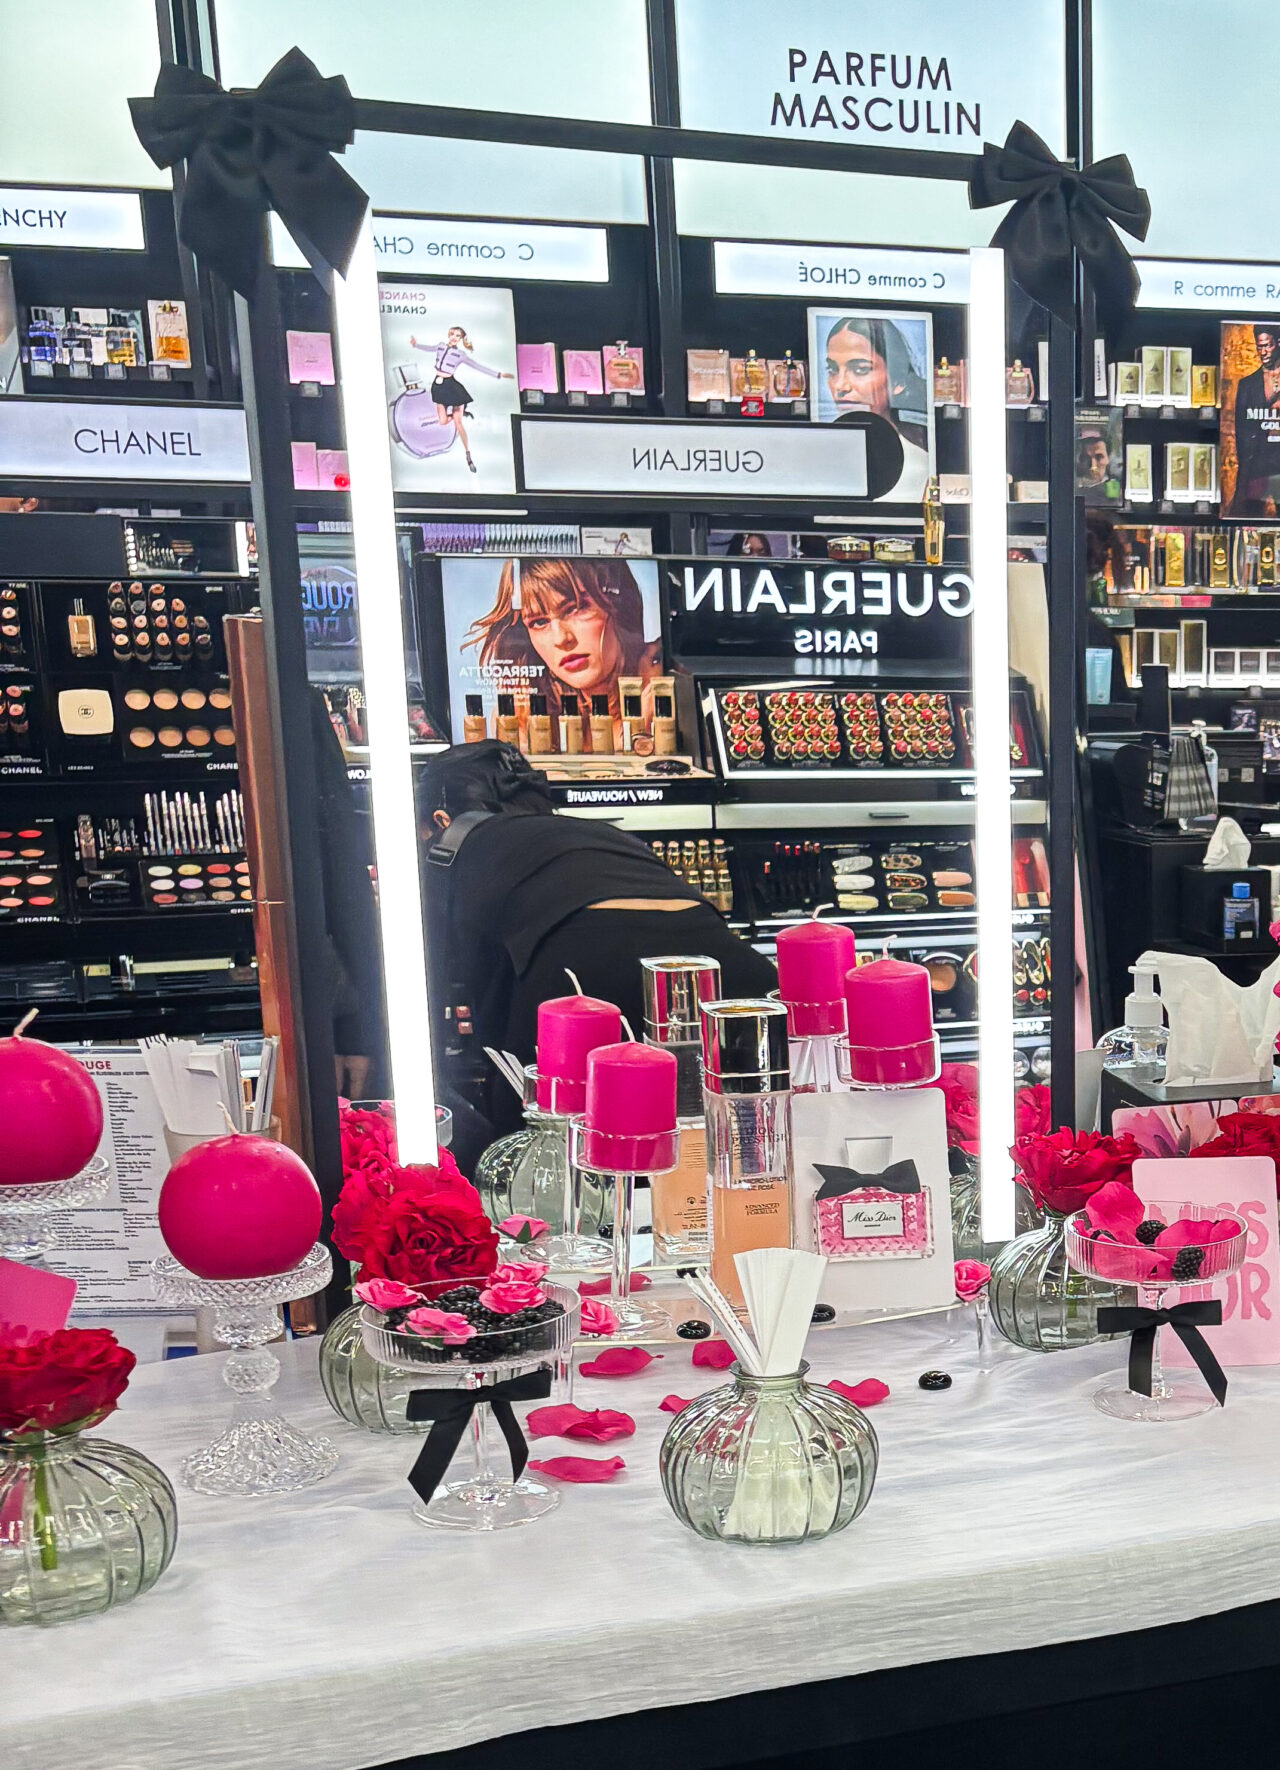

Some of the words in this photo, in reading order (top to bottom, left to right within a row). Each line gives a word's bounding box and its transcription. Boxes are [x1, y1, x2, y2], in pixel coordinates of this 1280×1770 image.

[788, 48, 952, 91] PARFUM
[770, 92, 982, 137] MASCULIN
[1173, 280, 1184, 295] R
[1193, 284, 1257, 298] comme
[74, 428, 202, 456] CHANEL
[1, 765, 43, 775] CHANEL
[847, 1211, 874, 1223] Miss
[875, 1210, 897, 1222] Dior
